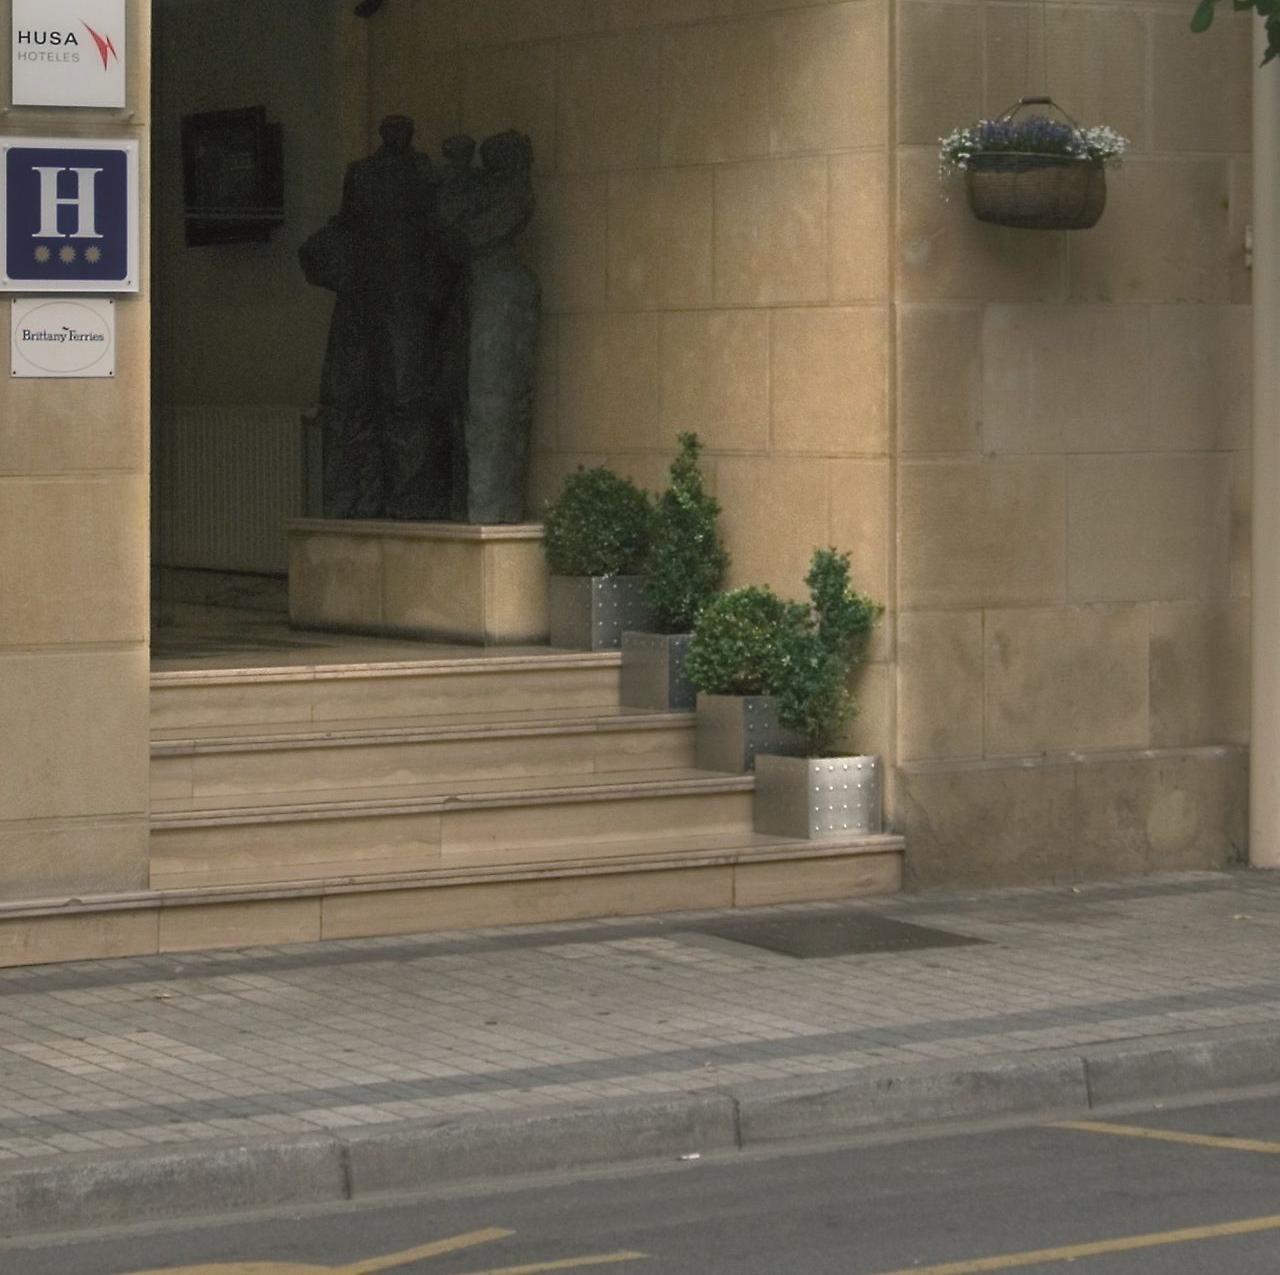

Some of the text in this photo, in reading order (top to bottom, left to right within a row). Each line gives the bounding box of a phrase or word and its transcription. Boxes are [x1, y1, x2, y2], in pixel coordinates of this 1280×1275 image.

[18, 30, 79, 46] HUSA
[18, 51, 80, 63] HOTELES
[31, 166, 104, 239] H
[22, 328, 104, 343] Brittany Ferries
